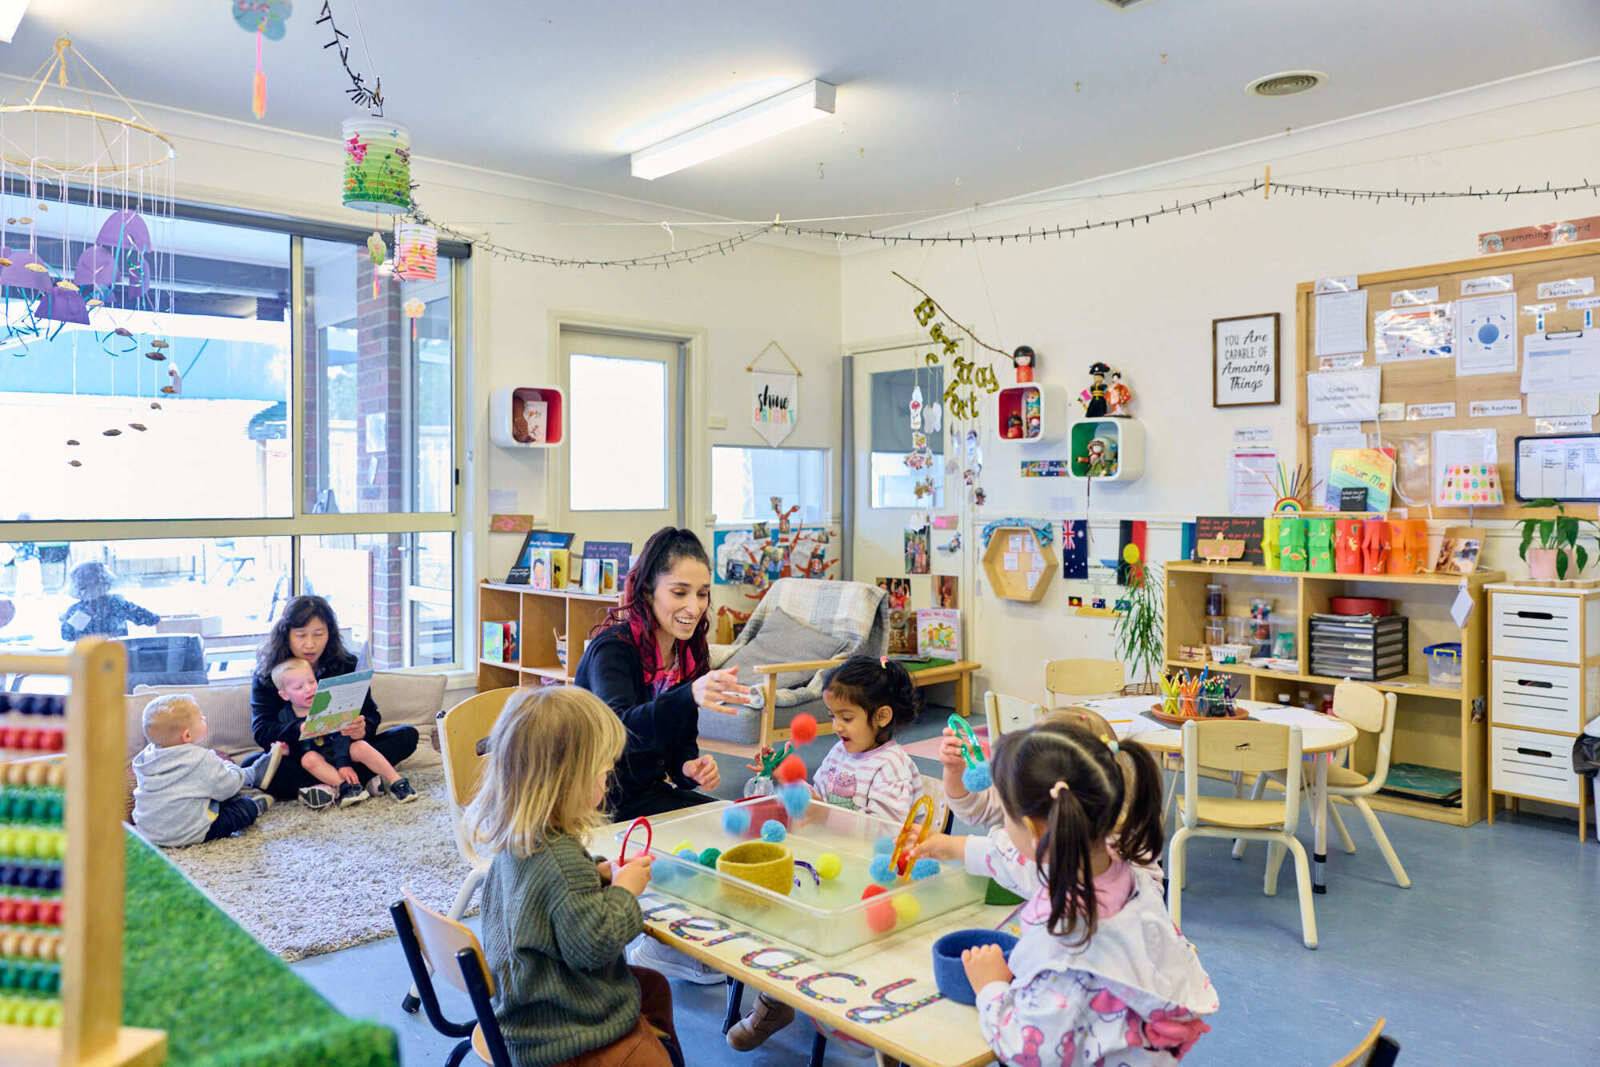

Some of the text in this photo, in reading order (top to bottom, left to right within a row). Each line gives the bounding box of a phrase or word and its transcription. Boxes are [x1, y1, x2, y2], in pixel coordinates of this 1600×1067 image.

[1224, 329, 1268, 346] YOU Are
[1224, 346, 1268, 361] CAPABLE OF
[1221, 360, 1270, 376] Amazing
[1230, 376, 1264, 393] Things
